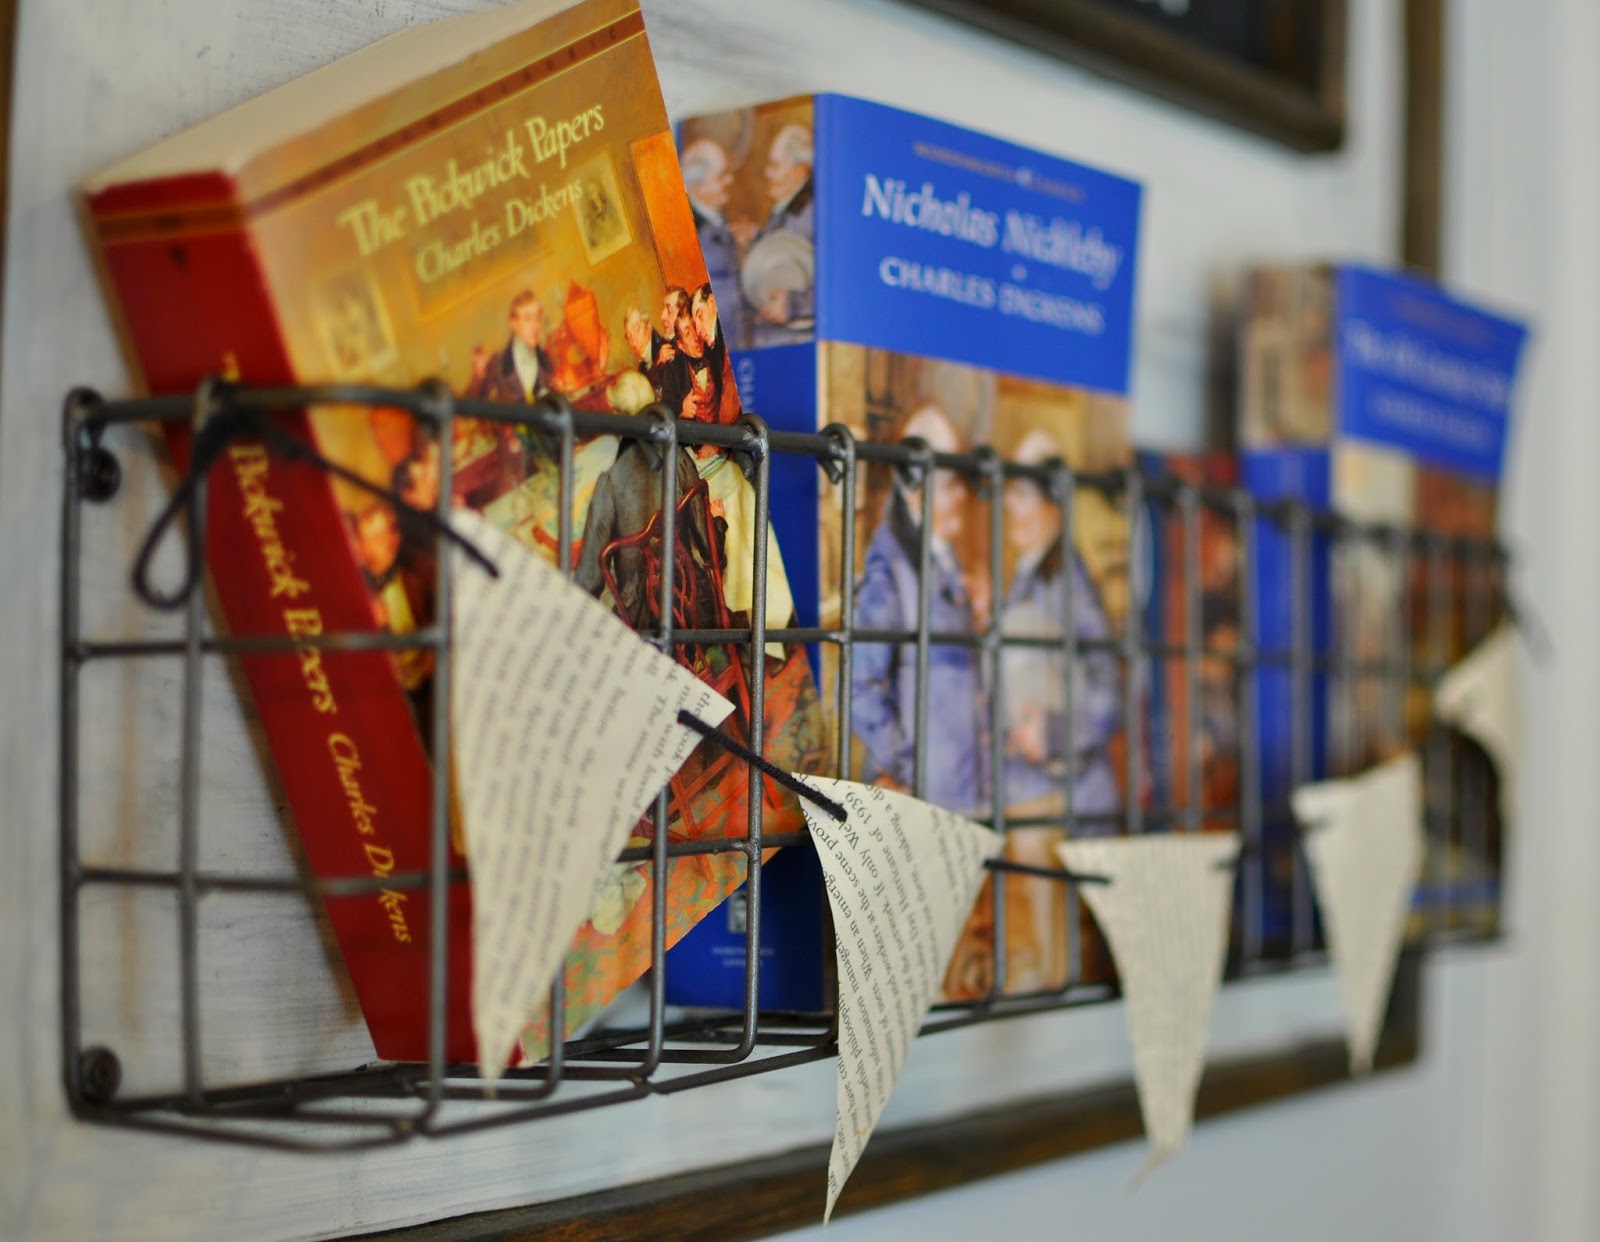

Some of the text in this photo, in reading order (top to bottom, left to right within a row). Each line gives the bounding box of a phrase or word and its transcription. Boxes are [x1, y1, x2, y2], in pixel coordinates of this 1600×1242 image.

[336, 198, 406, 257] The
[406, 129, 530, 226] Pickwick
[525, 104, 605, 169] Papers
[415, 179, 583, 284] Charles Dickens
[862, 173, 999, 248] Nicholas
[880, 255, 1105, 336] CHARLES DICKENS
[672, 728, 696, 761] ook
[282, 607, 338, 715] Ppers
[327, 733, 376, 835] Charles
[363, 841, 411, 944] Dikens
[846, 786, 872, 824] 1939.
[885, 804, 892, 812] a
[869, 827, 883, 842] of
[890, 813, 912, 862] making
[835, 851, 859, 887] scene
[860, 849, 878, 878] only
[882, 845, 909, 912] Hurricane
[858, 889, 869, 911] the
[874, 882, 885, 896] If
[850, 920, 859, 937] an
[868, 911, 875, 924] at
[882, 896, 904, 951] network.
[857, 938, 872, 981] When
[873, 925, 892, 975] workers
[857, 996, 880, 1065] information
